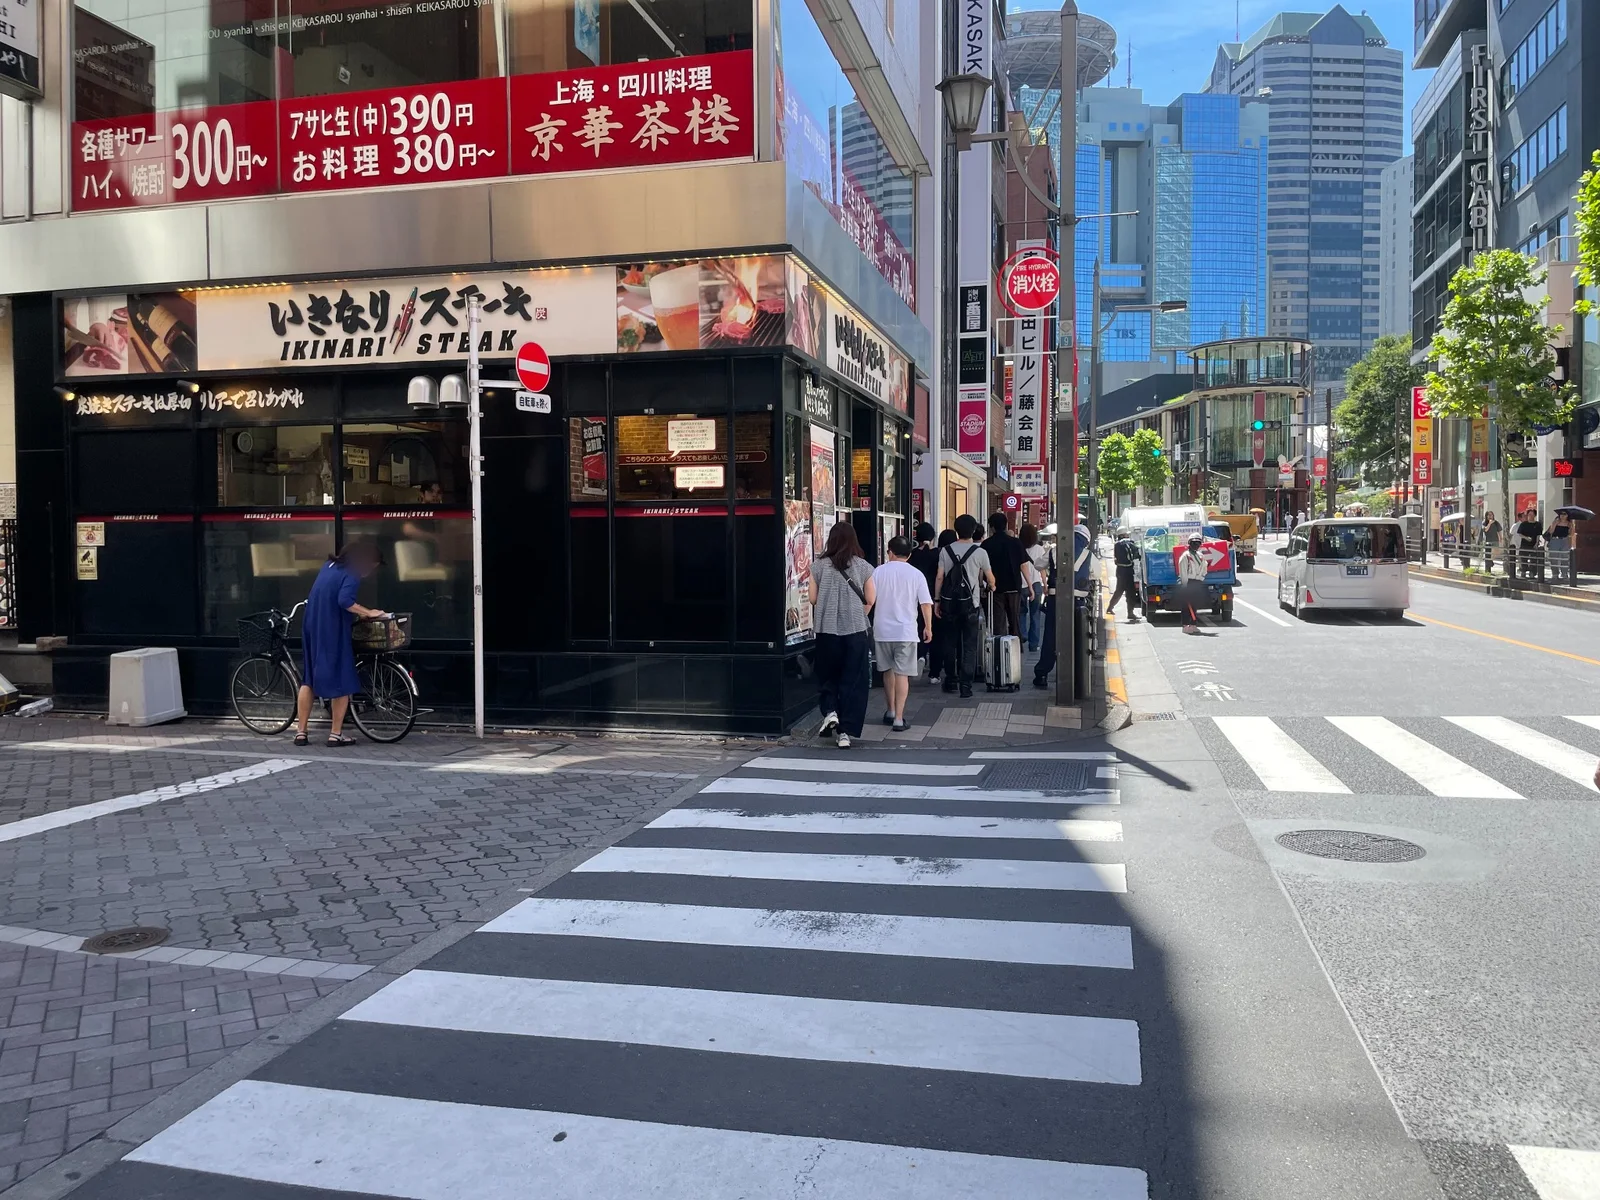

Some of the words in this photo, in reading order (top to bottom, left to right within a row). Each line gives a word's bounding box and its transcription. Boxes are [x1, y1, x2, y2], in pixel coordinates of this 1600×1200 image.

[223, 25, 253, 38] syanhai
[292, 13, 343, 28] KEIKASAROU
[347, 9, 378, 23] syanhai
[386, 6, 412, 17] shisen
[549, 65, 713, 106] 上海・四川料理
[1470, 44, 1488, 152] FIRST
[525, 92, 740, 162] 京華茶楼
[81, 126, 164, 163] 各種サワー
[292, 144, 380, 183] お料理
[1471, 162, 1489, 253] CABI
[1013, 272, 1056, 295] 消火栓
[1016, 264, 1027, 272] FIRE
[1028, 263, 1051, 271] HYDRANT
[269, 289, 390, 336] いきなり
[420, 281, 532, 326] ステーキ
[281, 337, 386, 361] IKINARI
[417, 330, 517, 355] STEAK
[1114, 328, 1137, 340] TBS
[519, 396, 549, 410] 自転車を除く
